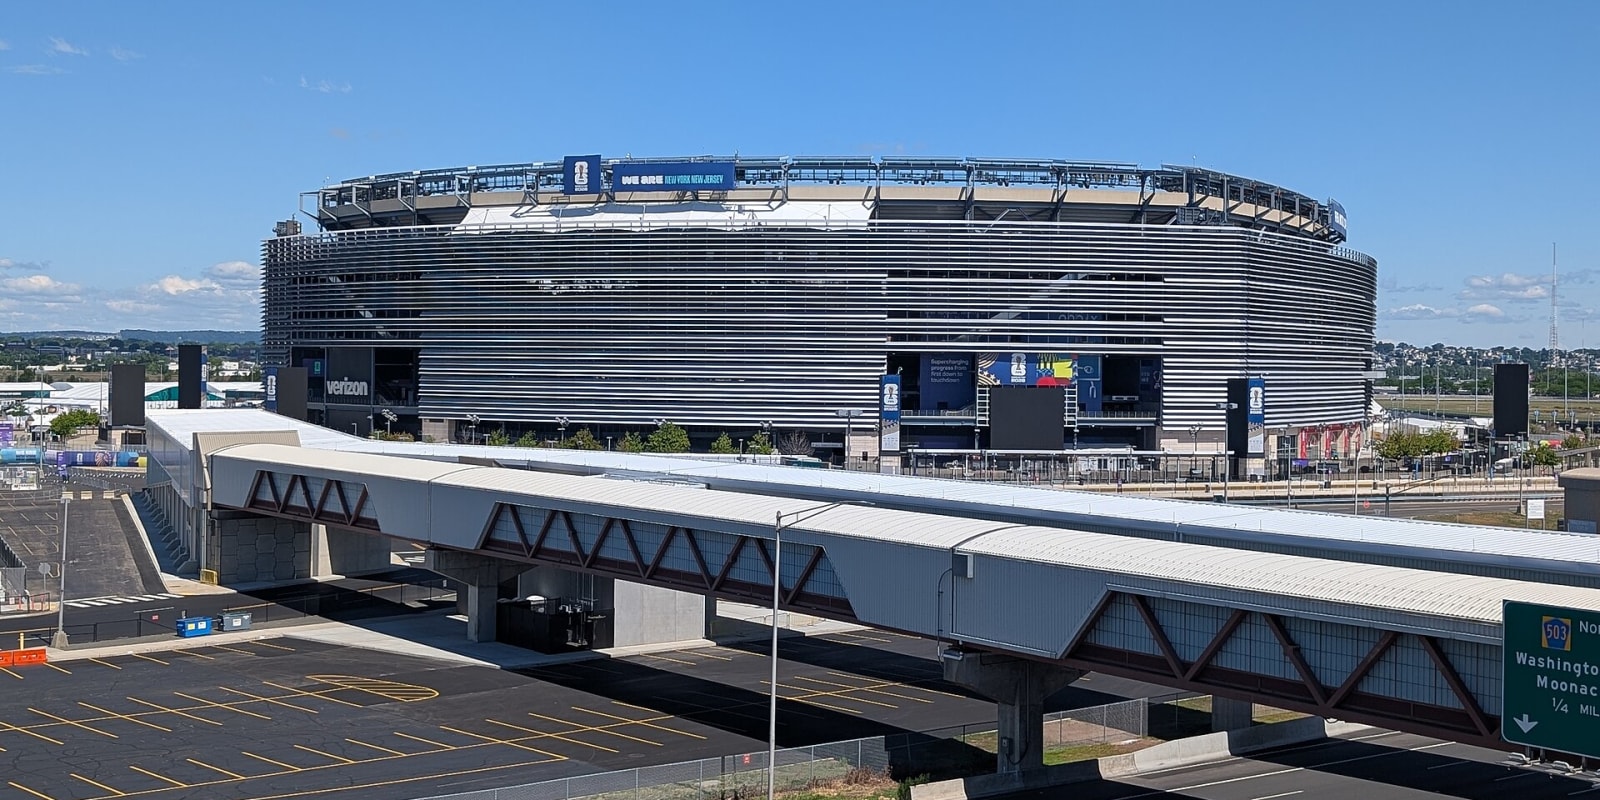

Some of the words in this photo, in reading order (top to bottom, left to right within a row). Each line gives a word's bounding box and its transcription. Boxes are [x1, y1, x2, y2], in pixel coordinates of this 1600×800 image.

[622, 175, 639, 185] WE
[641, 175, 664, 185] ARE
[664, 174, 677, 185] NEW
[677, 174, 690, 184] YORK
[690, 174, 704, 184] NEW
[703, 174, 724, 184] JERSEY
[326, 376, 368, 396] verizon
[1546, 624, 1567, 641] 503
[1579, 620, 1600, 635] No
[1515, 651, 1599, 678] Washingto
[1536, 674, 1598, 697] Moonac
[1580, 703, 1600, 717] MIL
